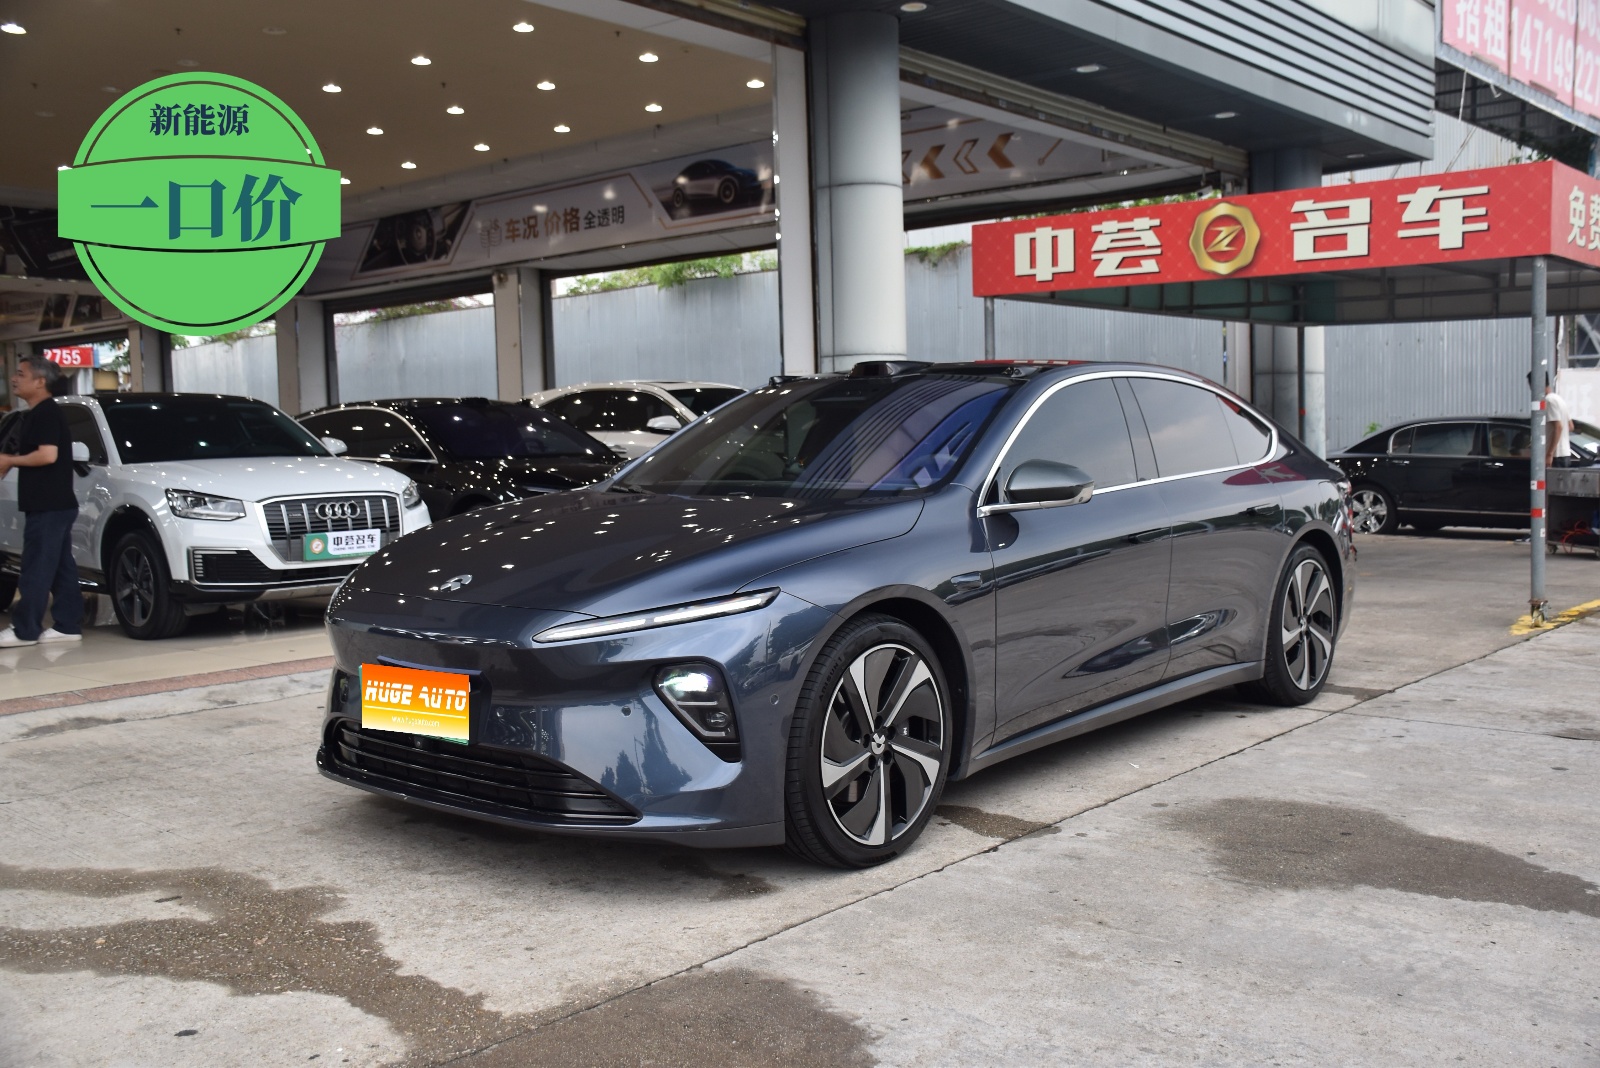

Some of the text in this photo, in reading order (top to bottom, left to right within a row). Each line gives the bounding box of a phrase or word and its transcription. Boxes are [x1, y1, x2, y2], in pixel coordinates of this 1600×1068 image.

[505, 205, 625, 242] 车况 价格 全透明
[1014, 217, 1161, 282] 中荟
[1290, 185, 1489, 261] 名车
[333, 533, 376, 547] 中荟名车
